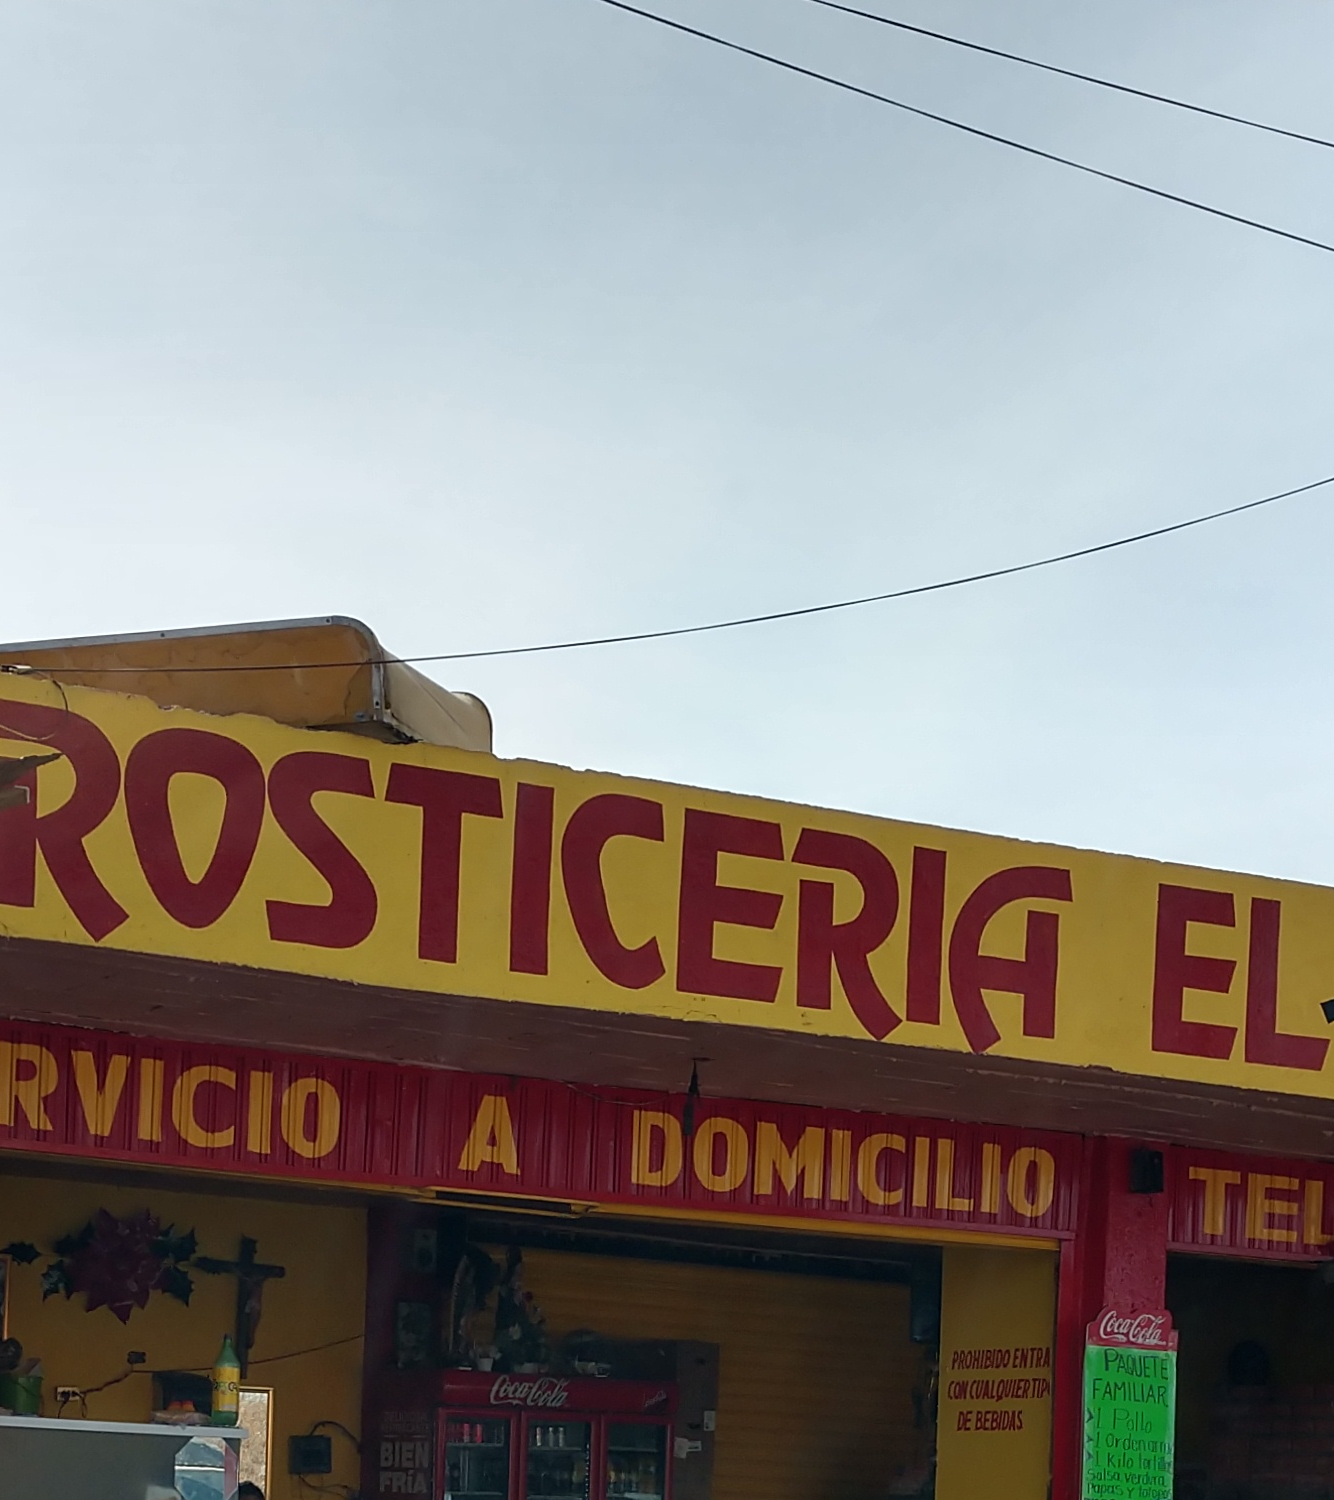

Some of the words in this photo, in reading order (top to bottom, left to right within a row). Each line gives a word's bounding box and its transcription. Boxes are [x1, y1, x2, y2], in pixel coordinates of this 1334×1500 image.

[1151, 884, 1331, 1072] EL
[457, 1094, 521, 1176] A
[631, 1109, 1056, 1219] DOMICILIO
[1099, 1309, 1167, 1346] Coca-Cola
[951, 1349, 1011, 1371] PROHIBIDO
[1103, 1347, 1169, 1381] PAQUETE
[489, 1373, 572, 1409] Coca-Cola
[947, 1380, 969, 1401] CON
[969, 1378, 1031, 1403] CUALQUIER
[956, 1410, 974, 1432] DE
[974, 1409, 1024, 1431] BEBIDAS
[1112, 1408, 1153, 1434] Pollo
[379, 1440, 430, 1469] BIEN
[1107, 1451, 1135, 1470] Kilo
